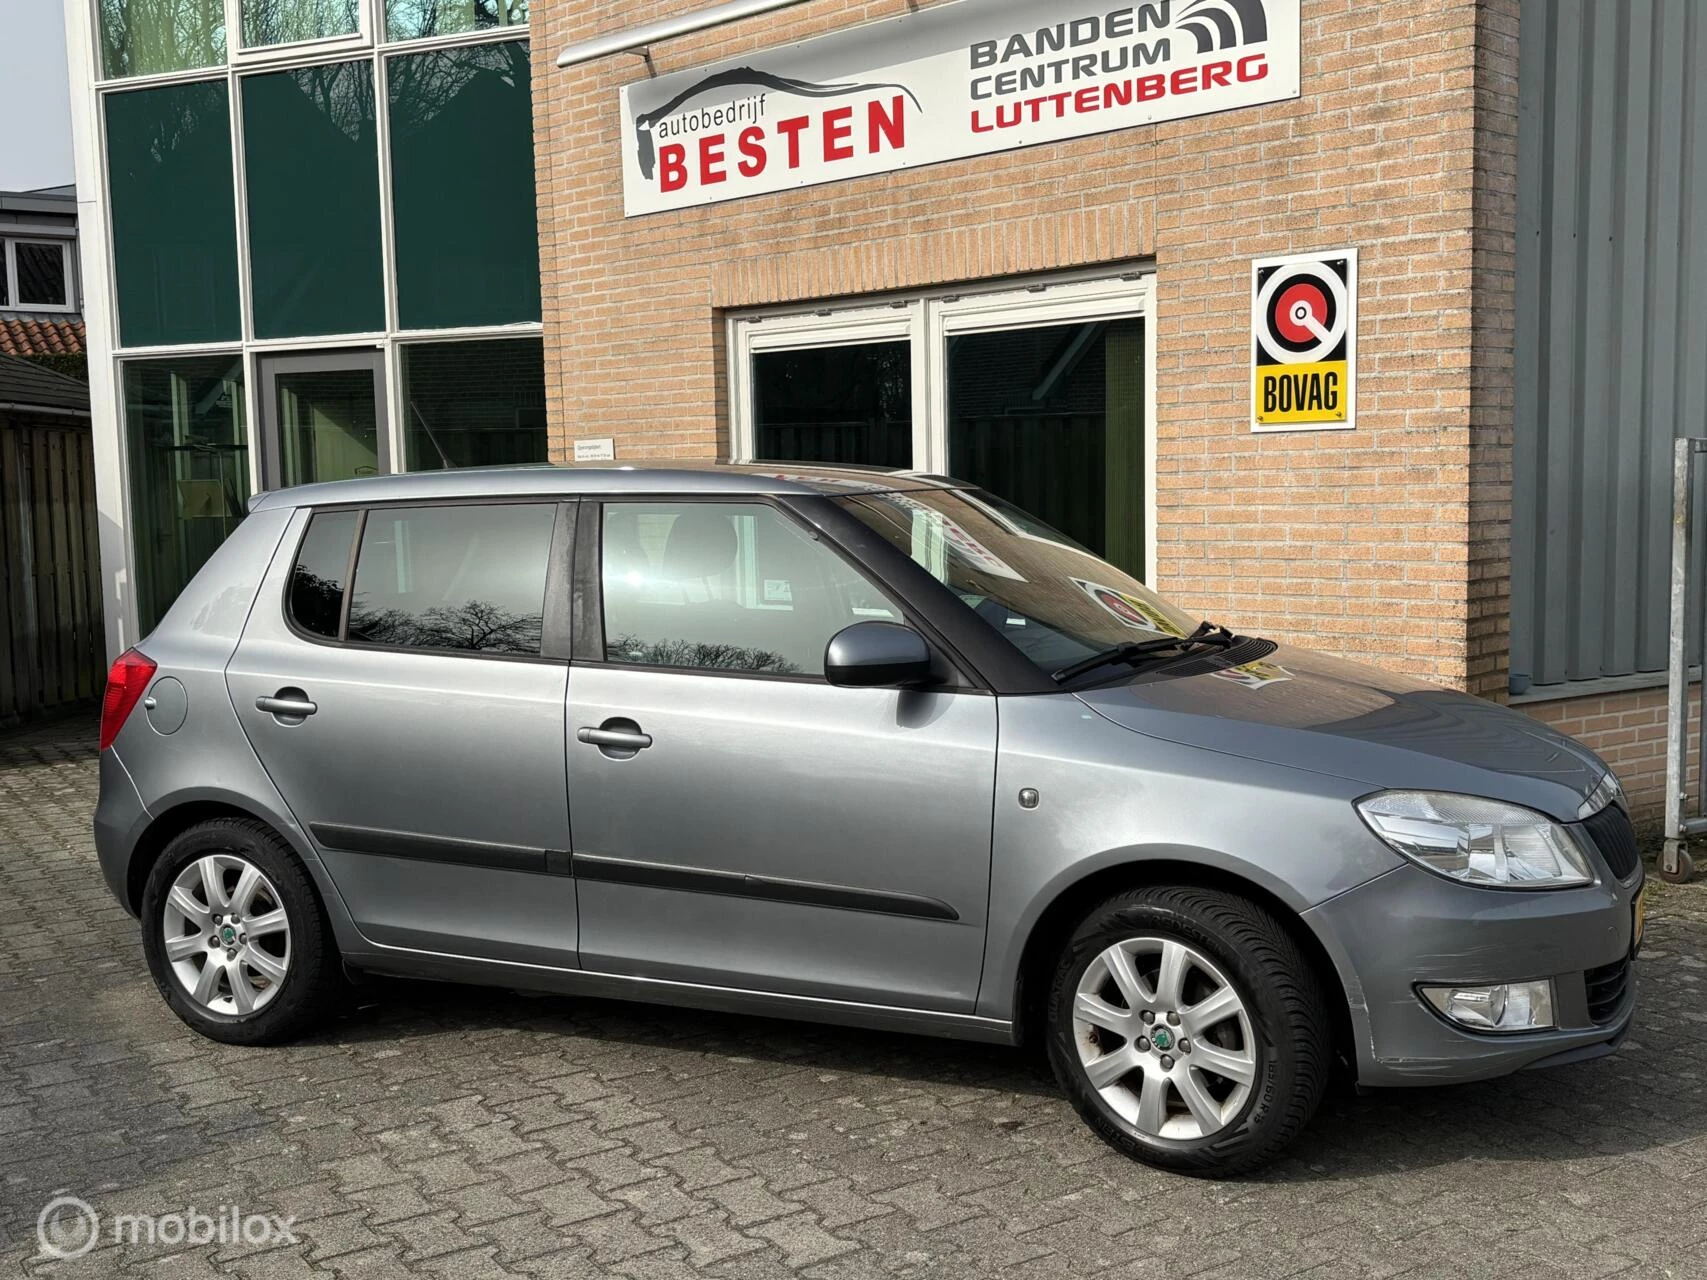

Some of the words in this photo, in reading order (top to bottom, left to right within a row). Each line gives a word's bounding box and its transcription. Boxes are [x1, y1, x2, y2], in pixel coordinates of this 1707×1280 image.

[970, 0, 1170, 70] BANDEN
[970, 38, 1171, 101] CENTRUM
[970, 53, 1268, 133] LUTTENBERG
[659, 93, 767, 138] autobedrijf
[659, 95, 905, 193] BESTEN
[1263, 371, 1338, 413] BOVAG
